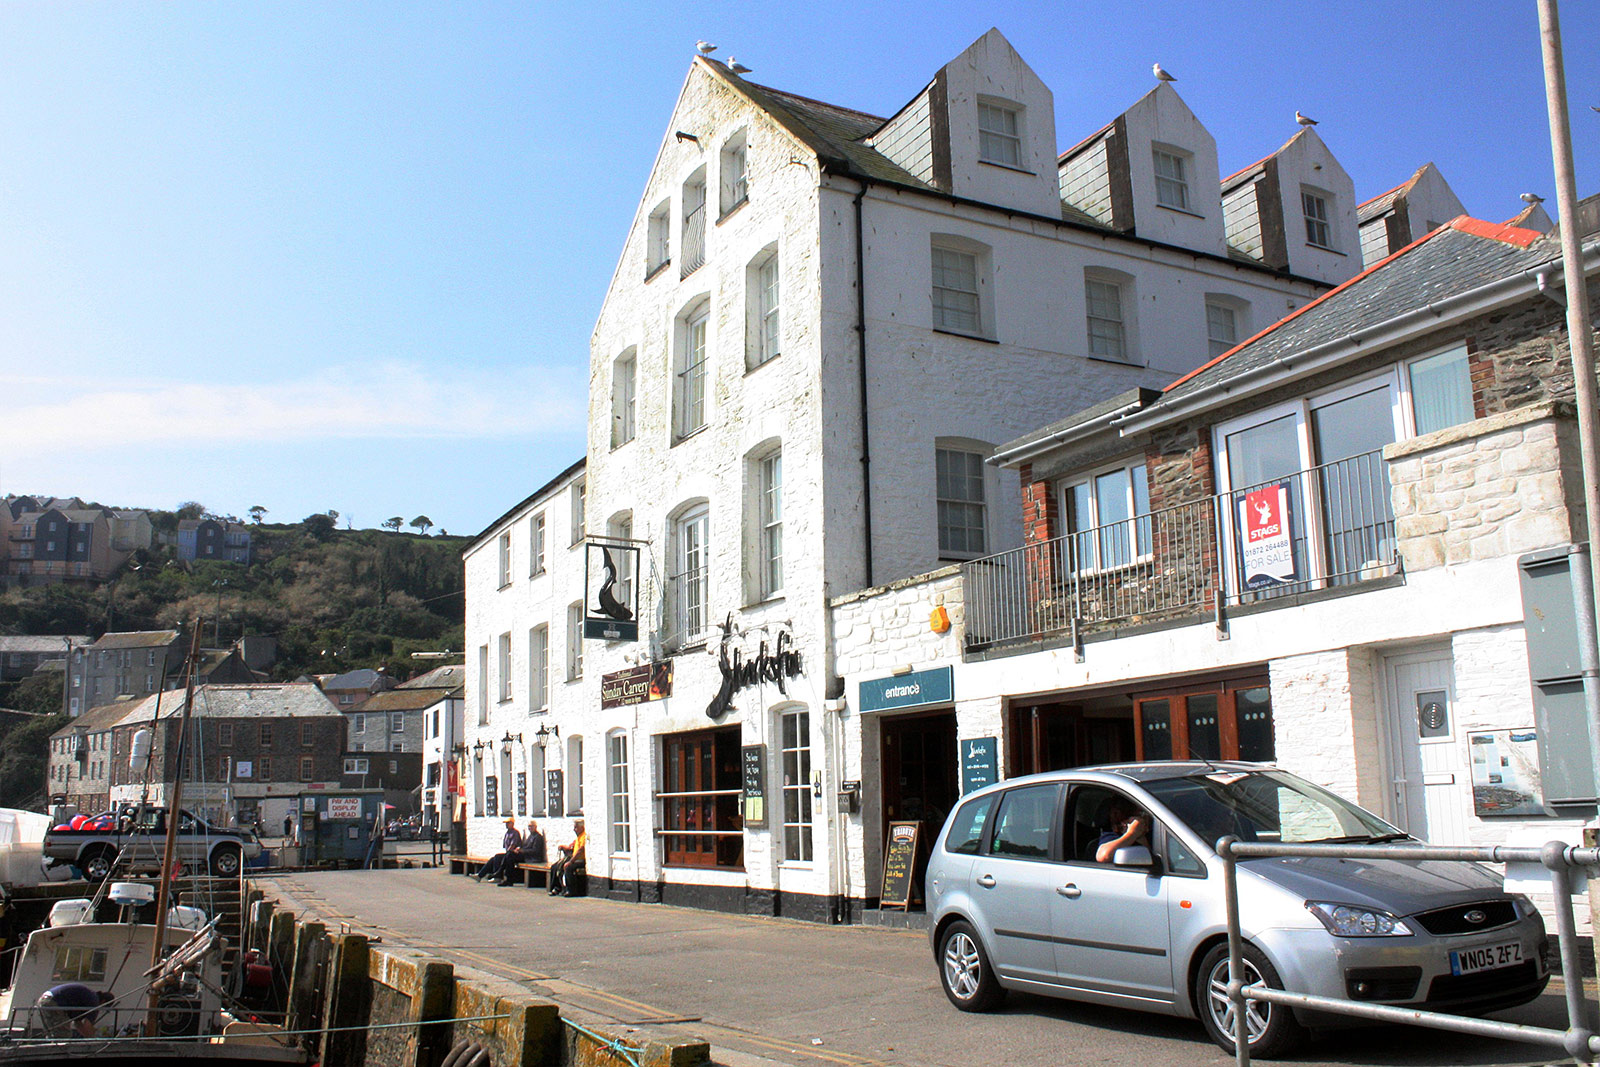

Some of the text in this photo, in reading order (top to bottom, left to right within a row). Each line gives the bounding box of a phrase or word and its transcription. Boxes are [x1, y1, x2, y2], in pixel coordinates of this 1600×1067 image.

[1250, 524, 1279, 539] STAGS
[1245, 546, 1264, 557] 01872
[1246, 551, 1291, 571] FOR SALE
[623, 680, 649, 696] Carvery
[885, 682, 920, 699] entrance
[1459, 943, 1522, 971] WN05 ZFZ
